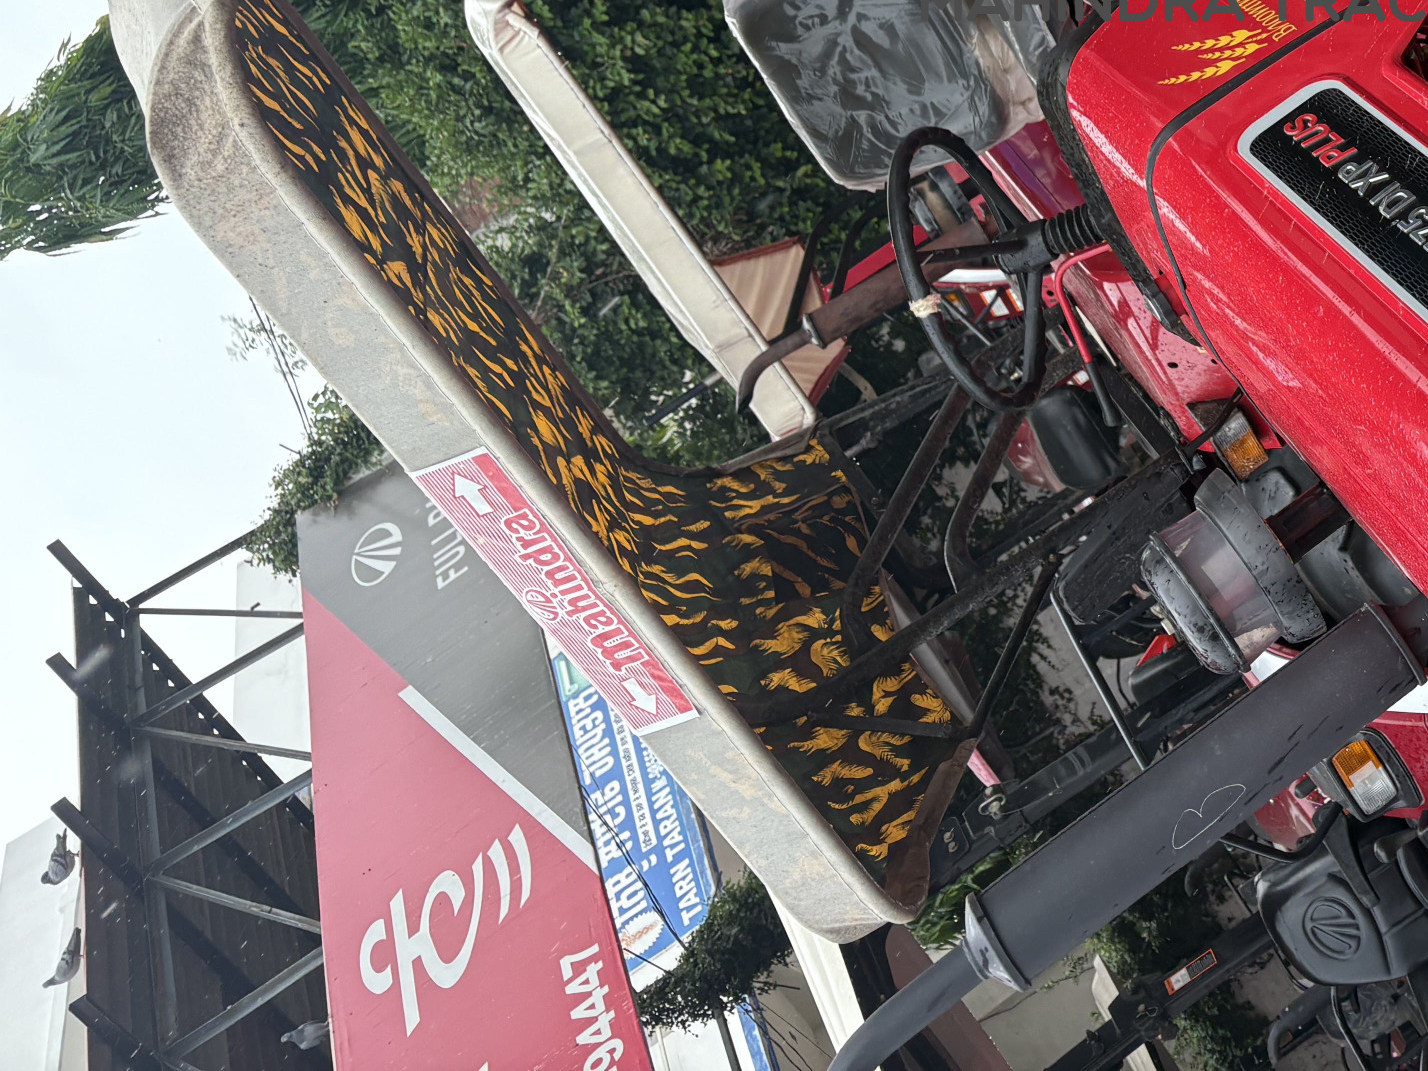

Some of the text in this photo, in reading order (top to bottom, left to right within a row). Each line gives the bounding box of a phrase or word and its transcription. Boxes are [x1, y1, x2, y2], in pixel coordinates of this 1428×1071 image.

[1283, 113, 1358, 168] PLUS
[1337, 160, 1390, 197] XP
[1369, 181, 1412, 220] DI
[430, 528, 469, 590] FULL
[650, 786, 687, 860] TARAN
[669, 857, 704, 927] TARN
